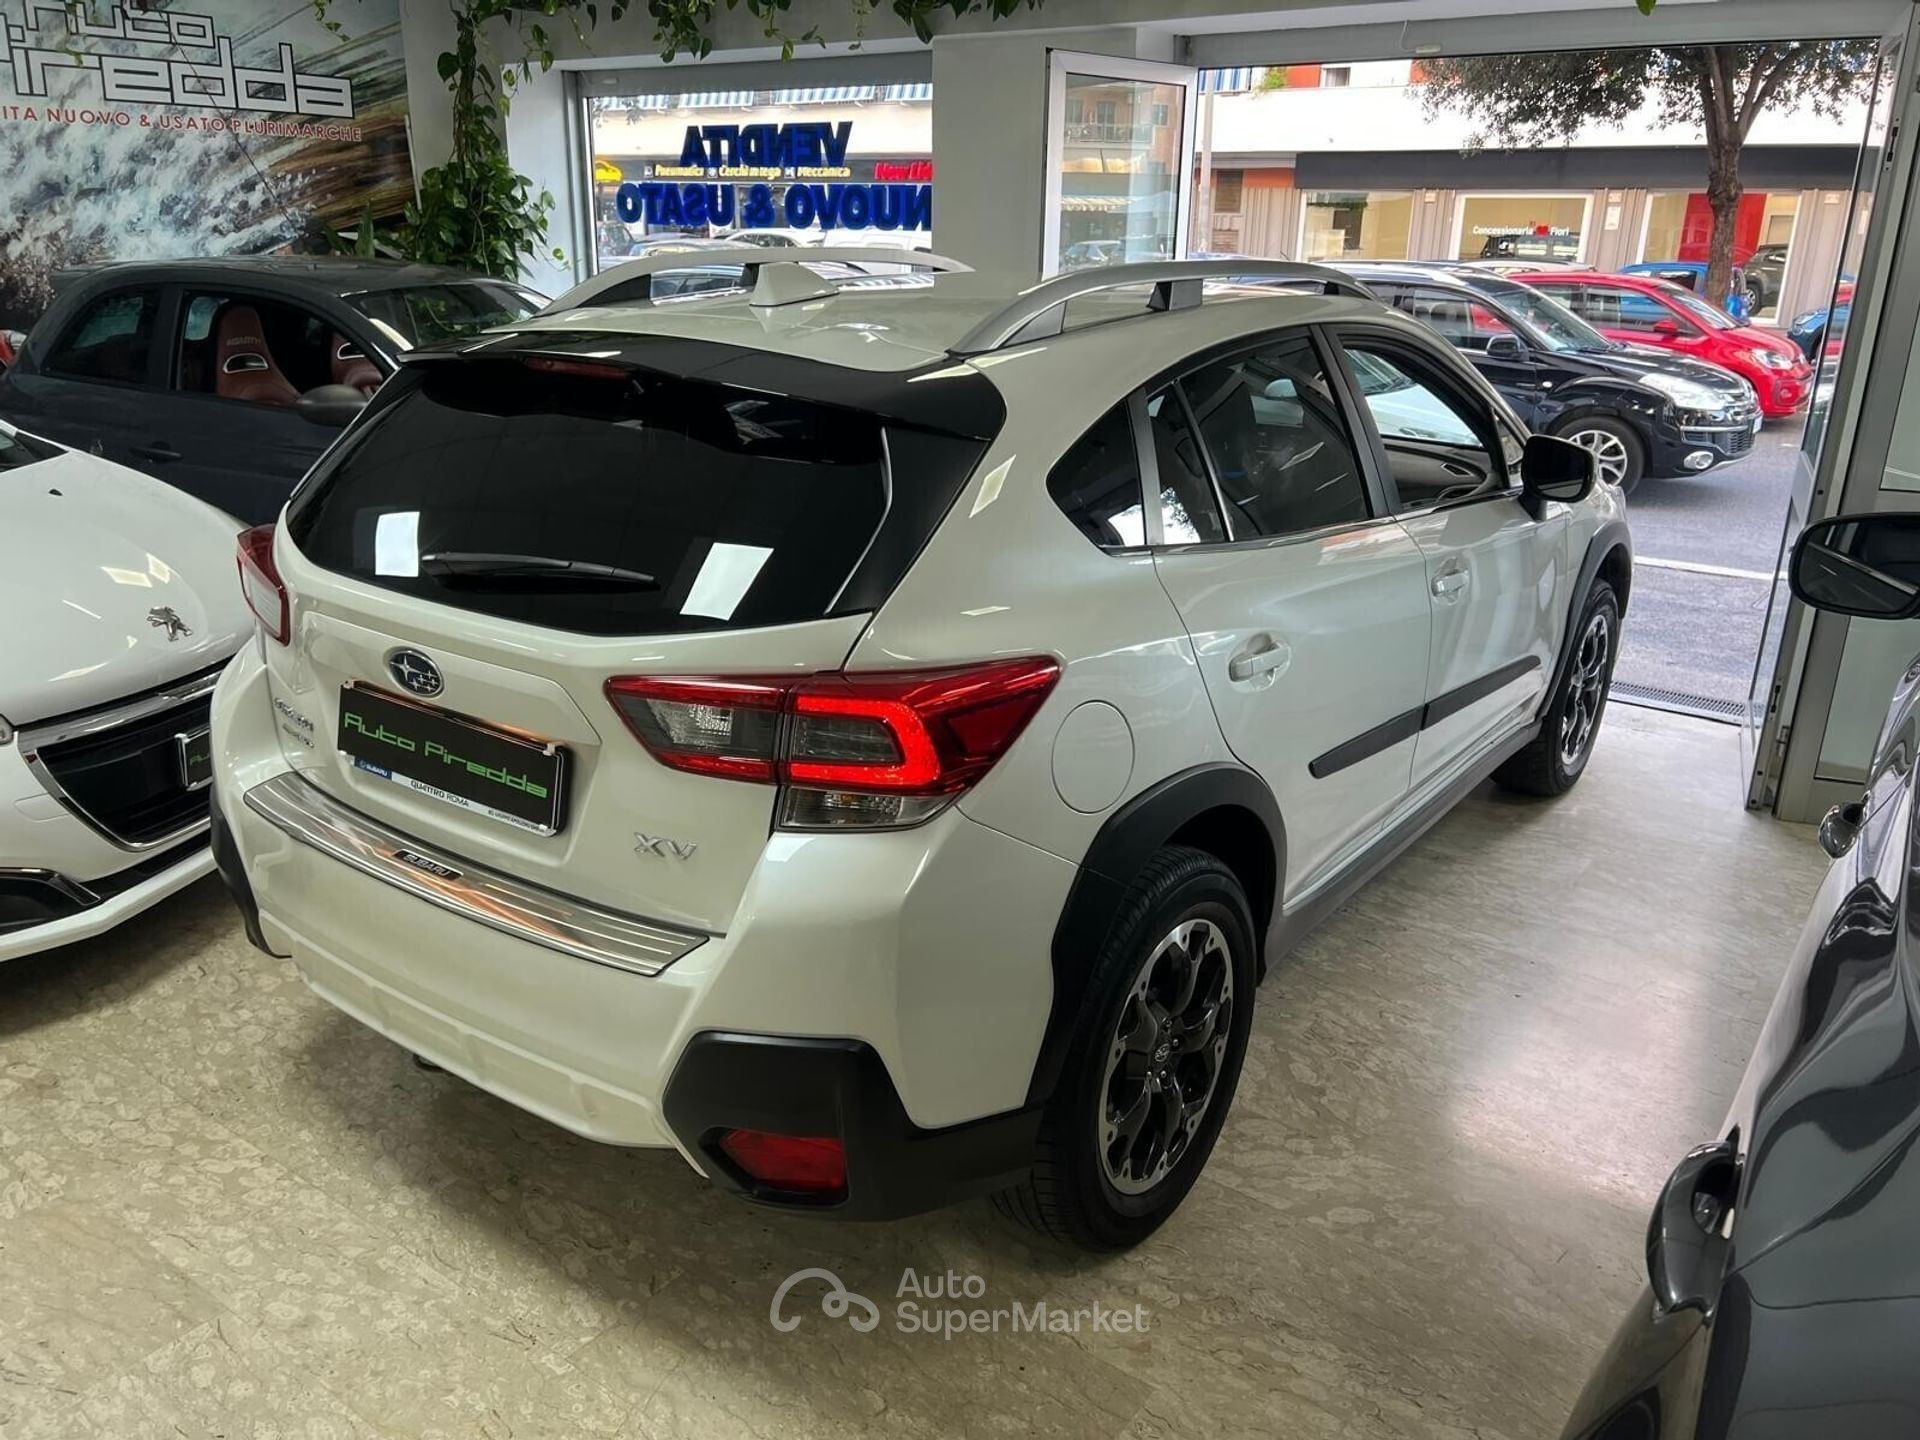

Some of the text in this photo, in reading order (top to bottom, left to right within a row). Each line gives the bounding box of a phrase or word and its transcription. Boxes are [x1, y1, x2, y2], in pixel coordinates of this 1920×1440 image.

[0, 12, 355, 118] iredda
[46, 108, 130, 126] NUOVO
[140, 115, 150, 127] &
[159, 115, 226, 132] USATO
[233, 121, 362, 142] PLURIMARCHE
[344, 712, 416, 751] Auto
[424, 741, 547, 798] Piredda
[633, 831, 697, 861] XV
[403, 854, 450, 877] SUBARU
